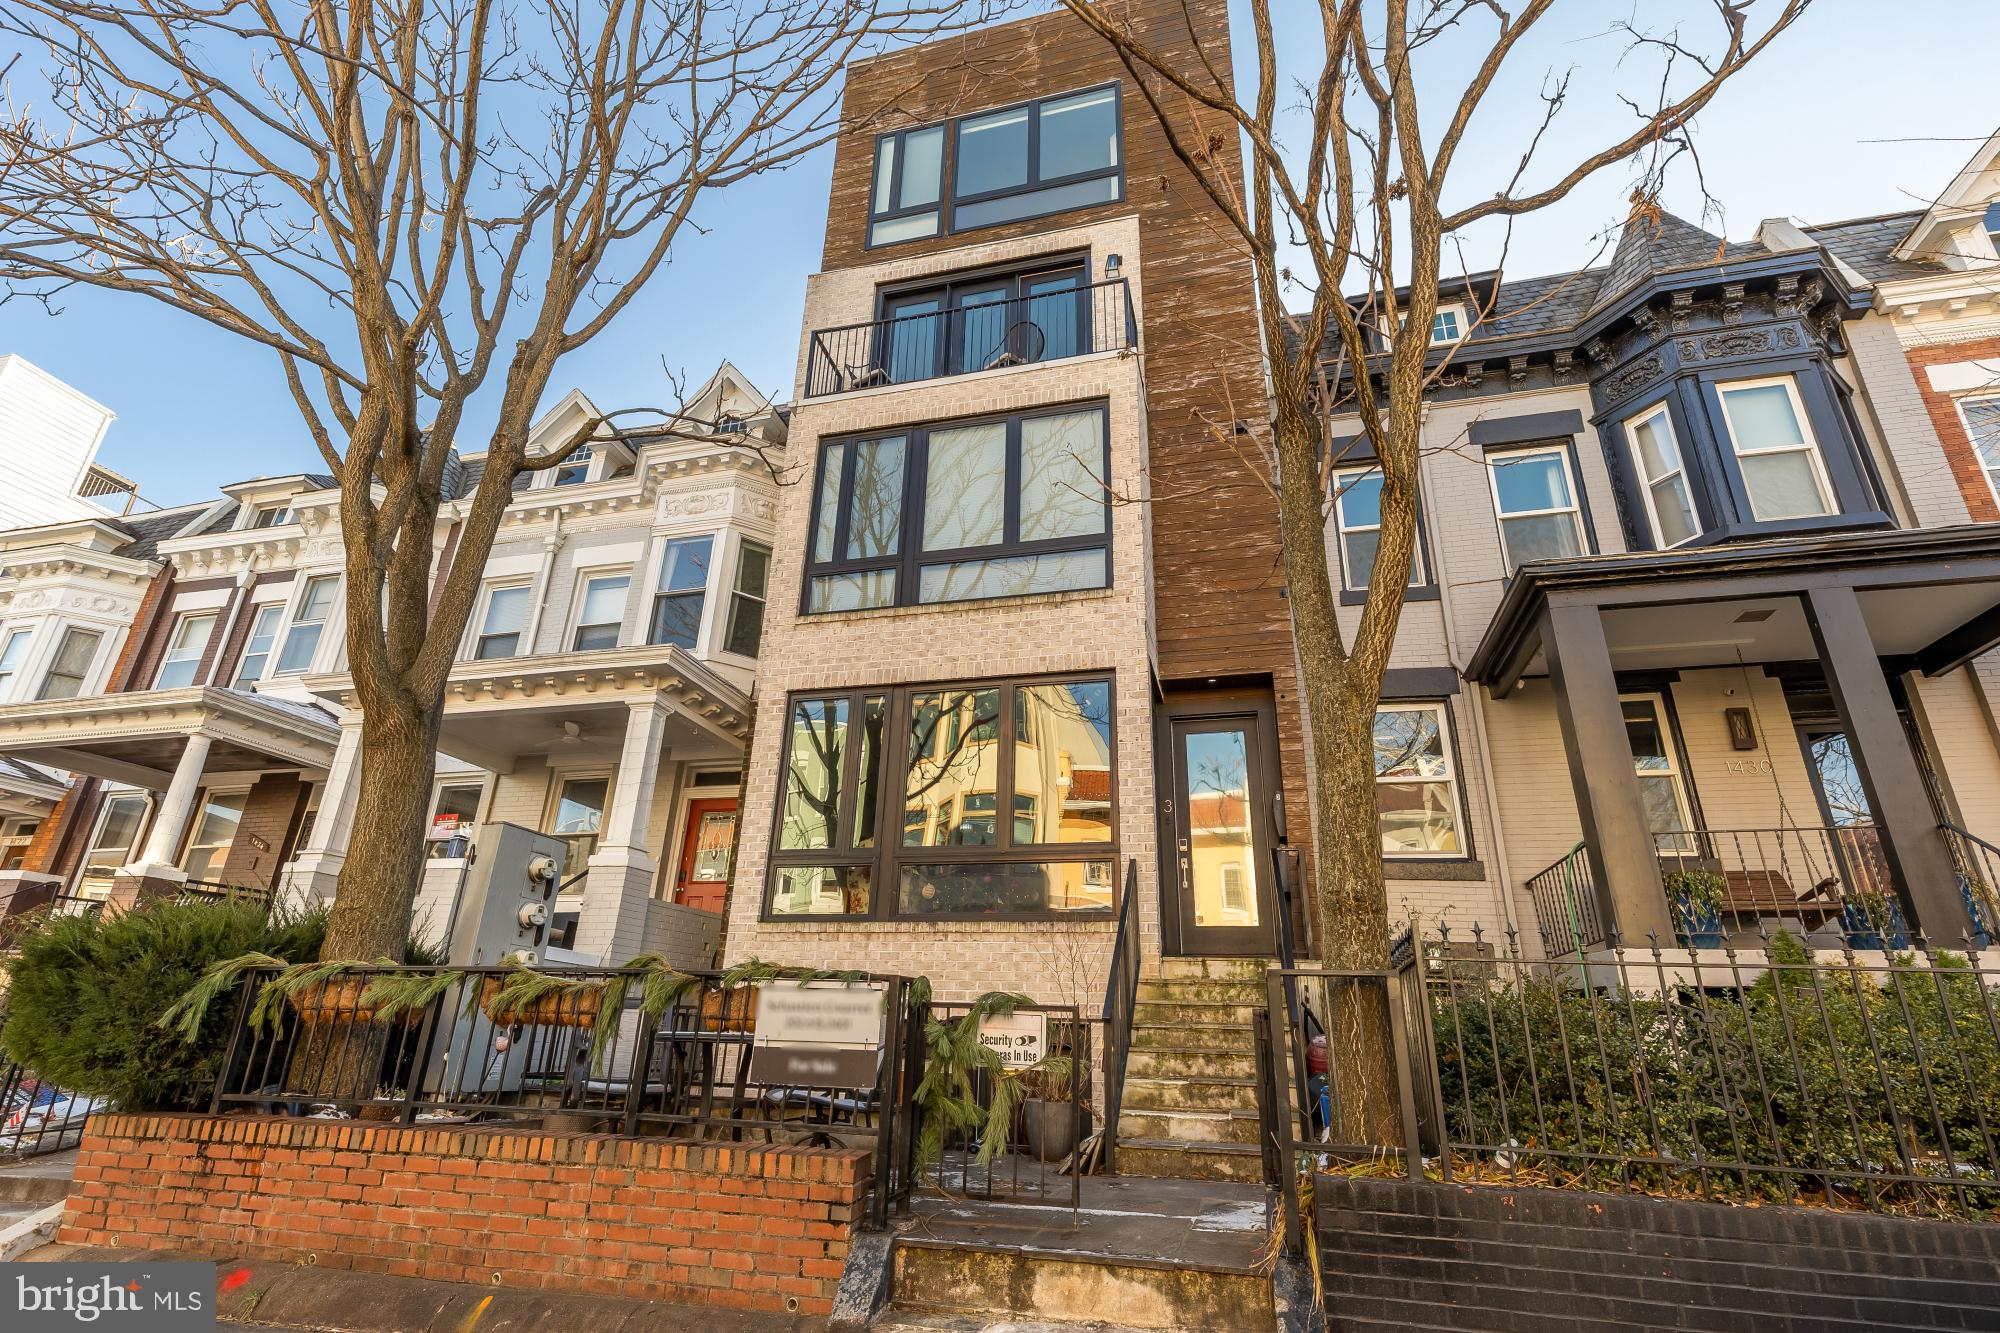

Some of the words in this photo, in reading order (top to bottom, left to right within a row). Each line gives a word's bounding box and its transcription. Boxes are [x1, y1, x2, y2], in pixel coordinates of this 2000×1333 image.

[1725, 760, 1773, 775] 1430
[1163, 799, 1173, 813] 3
[980, 1033, 1012, 1048] Security
[996, 1051, 1012, 1061] eras
[1013, 1050, 1021, 1061] In
[1023, 1050, 1037, 1062] Use
